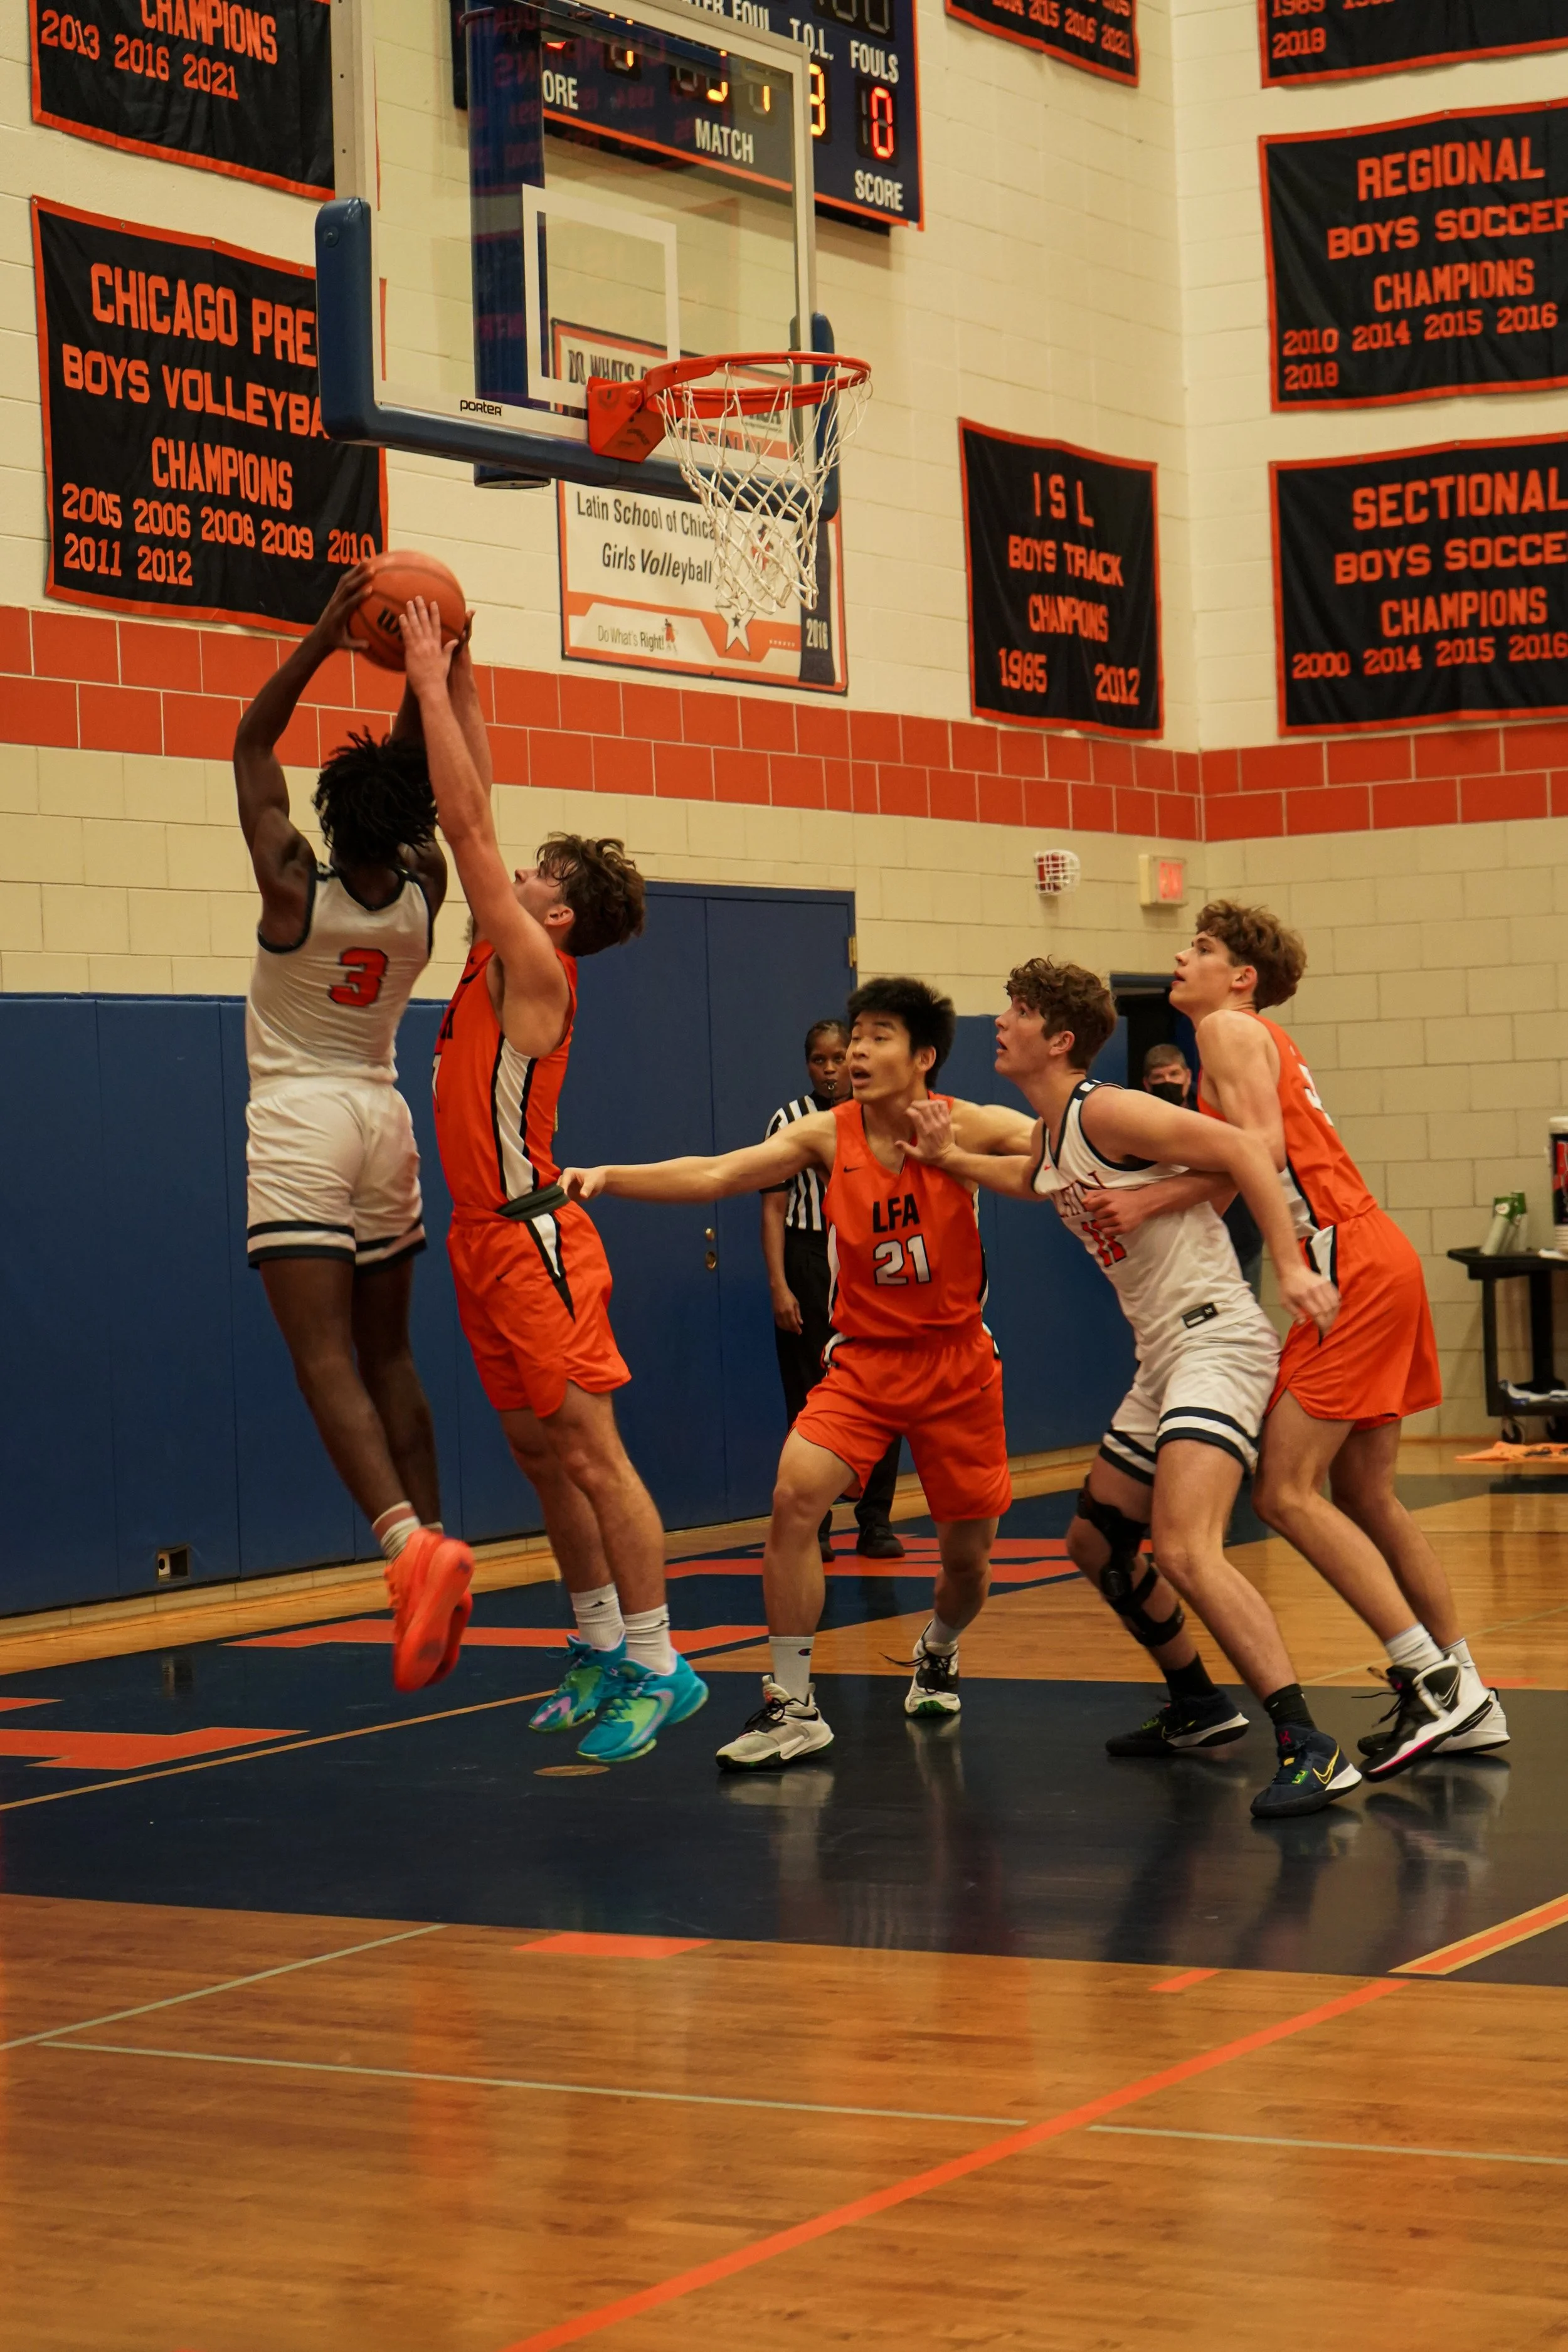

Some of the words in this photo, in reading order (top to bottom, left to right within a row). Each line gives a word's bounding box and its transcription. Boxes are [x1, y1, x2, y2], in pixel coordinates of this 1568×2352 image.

[41, 9, 100, 61] 2013
[114, 34, 169, 81] 2016
[183, 54, 238, 100] 2021
[140, 0, 278, 65] CHAMPIONS
[789, 18, 834, 61] TO.L.
[1272, 27, 1327, 59] 2018
[850, 40, 899, 84] FOULS
[695, 118, 754, 164] MATCH
[854, 169, 904, 212] SCORE
[1357, 137, 1545, 201] REGIONAL
[1327, 216, 1419, 260] BOYS
[1374, 258, 1535, 313] CHAMPIONS
[90, 263, 238, 347] CHICAGO
[252, 298, 318, 367] PRE
[1283, 328, 1339, 356] 2010
[1352, 319, 1411, 351] 2014
[1424, 309, 1483, 341] 2015
[1496, 302, 1557, 334] 2016
[62, 343, 151, 405] BOYS
[568, 349, 586, 386] DO
[1284, 361, 1339, 391] 2018
[152, 437, 293, 511] CHAMPIONS
[1353, 467, 1568, 531] SECTIONAL
[62, 482, 122, 529] 2005
[133, 498, 190, 539] 2006
[201, 506, 255, 548] 2008
[262, 519, 314, 560] 2009
[327, 529, 376, 565] 2010
[576, 491, 609, 521] Latin
[613, 499, 663, 529] School
[666, 510, 677, 533] of
[681, 511, 723, 542] Chica
[64, 533, 122, 577] 2011
[137, 546, 193, 586] 2012
[602, 543, 635, 571] Girls
[641, 549, 712, 585] Volleyball
[1008, 535, 1056, 573] BOYS
[1062, 541, 1124, 587] TRACK
[1335, 544, 1432, 585] BOYS
[1029, 593, 1109, 643] CHAMPONS
[1381, 586, 1548, 638] CHAMPIONS
[598, 625, 610, 643] Do
[610, 627, 638, 647] What's
[640, 632, 665, 652] Right!
[1292, 650, 1351, 680] 2000
[1364, 644, 1423, 676] 2014
[1435, 637, 1496, 667] 2015
[1508, 631, 1568, 662] 2016
[999, 647, 1047, 694] 1985
[1094, 663, 1140, 706] 2012
[327, 947, 389, 1008] 3
[872, 1193, 920, 1233] LFA
[873, 1233, 931, 1287] 21
